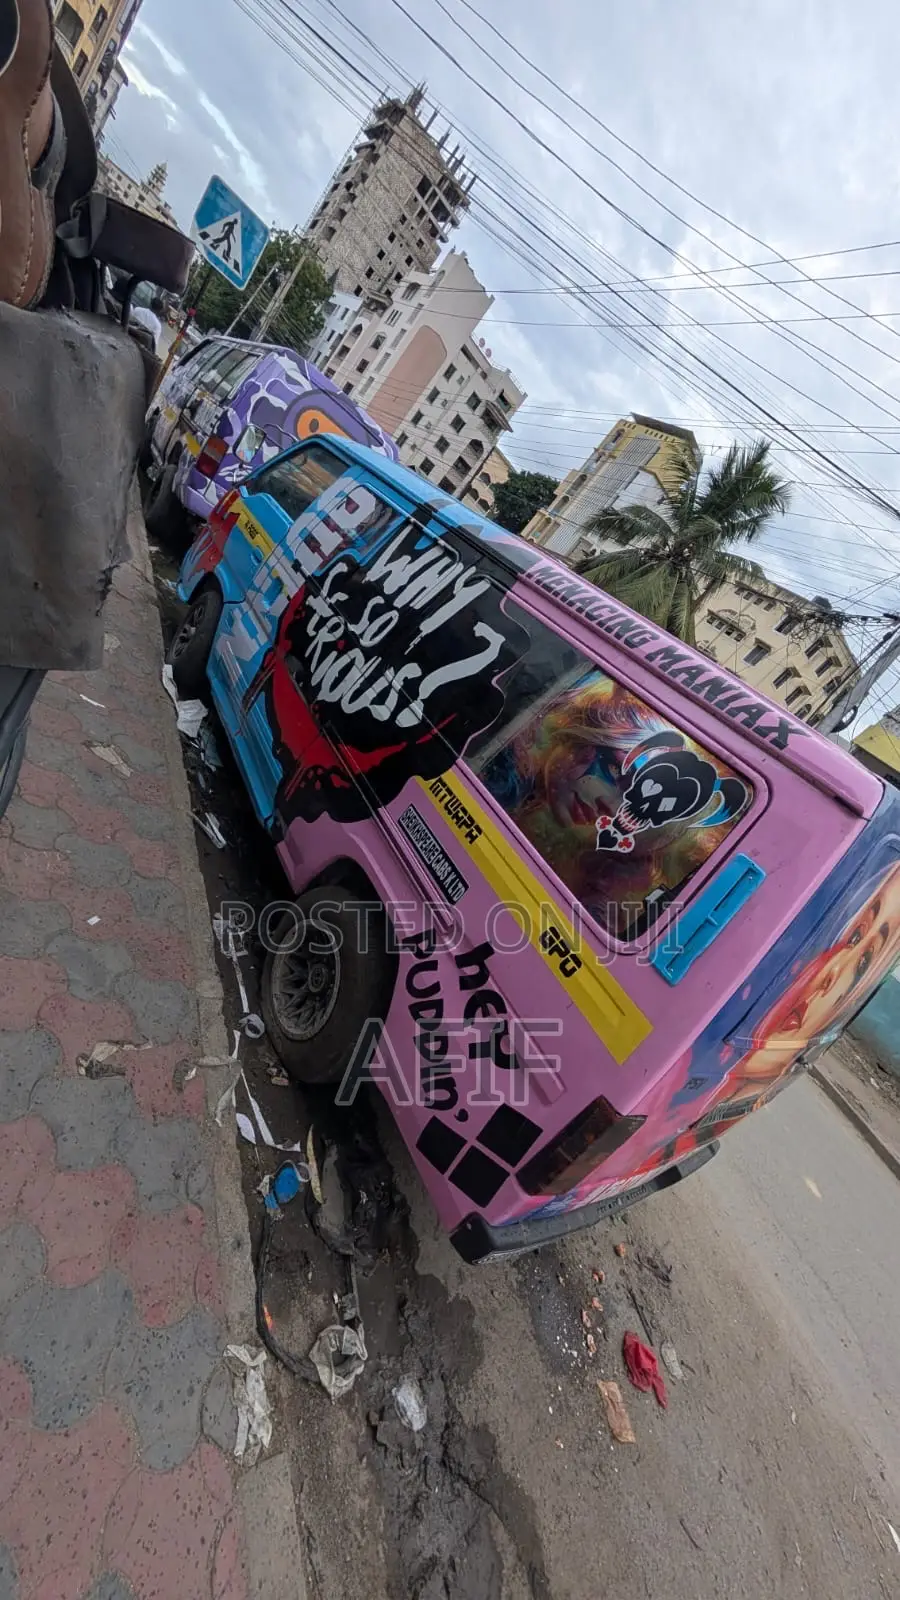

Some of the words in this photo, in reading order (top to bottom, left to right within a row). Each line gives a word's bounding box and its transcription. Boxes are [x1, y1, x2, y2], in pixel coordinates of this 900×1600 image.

[362, 523, 491, 655] WHY
[347, 595, 399, 647] SO
[531, 565, 660, 649] MENACING
[645, 645, 808, 751] MANIAX
[429, 777, 483, 845] MTWAPA
[432, 853, 452, 881] CABS
[443, 871, 457, 889] K
[448, 878, 466, 902] LTD
[539, 926, 582, 978] GPO
